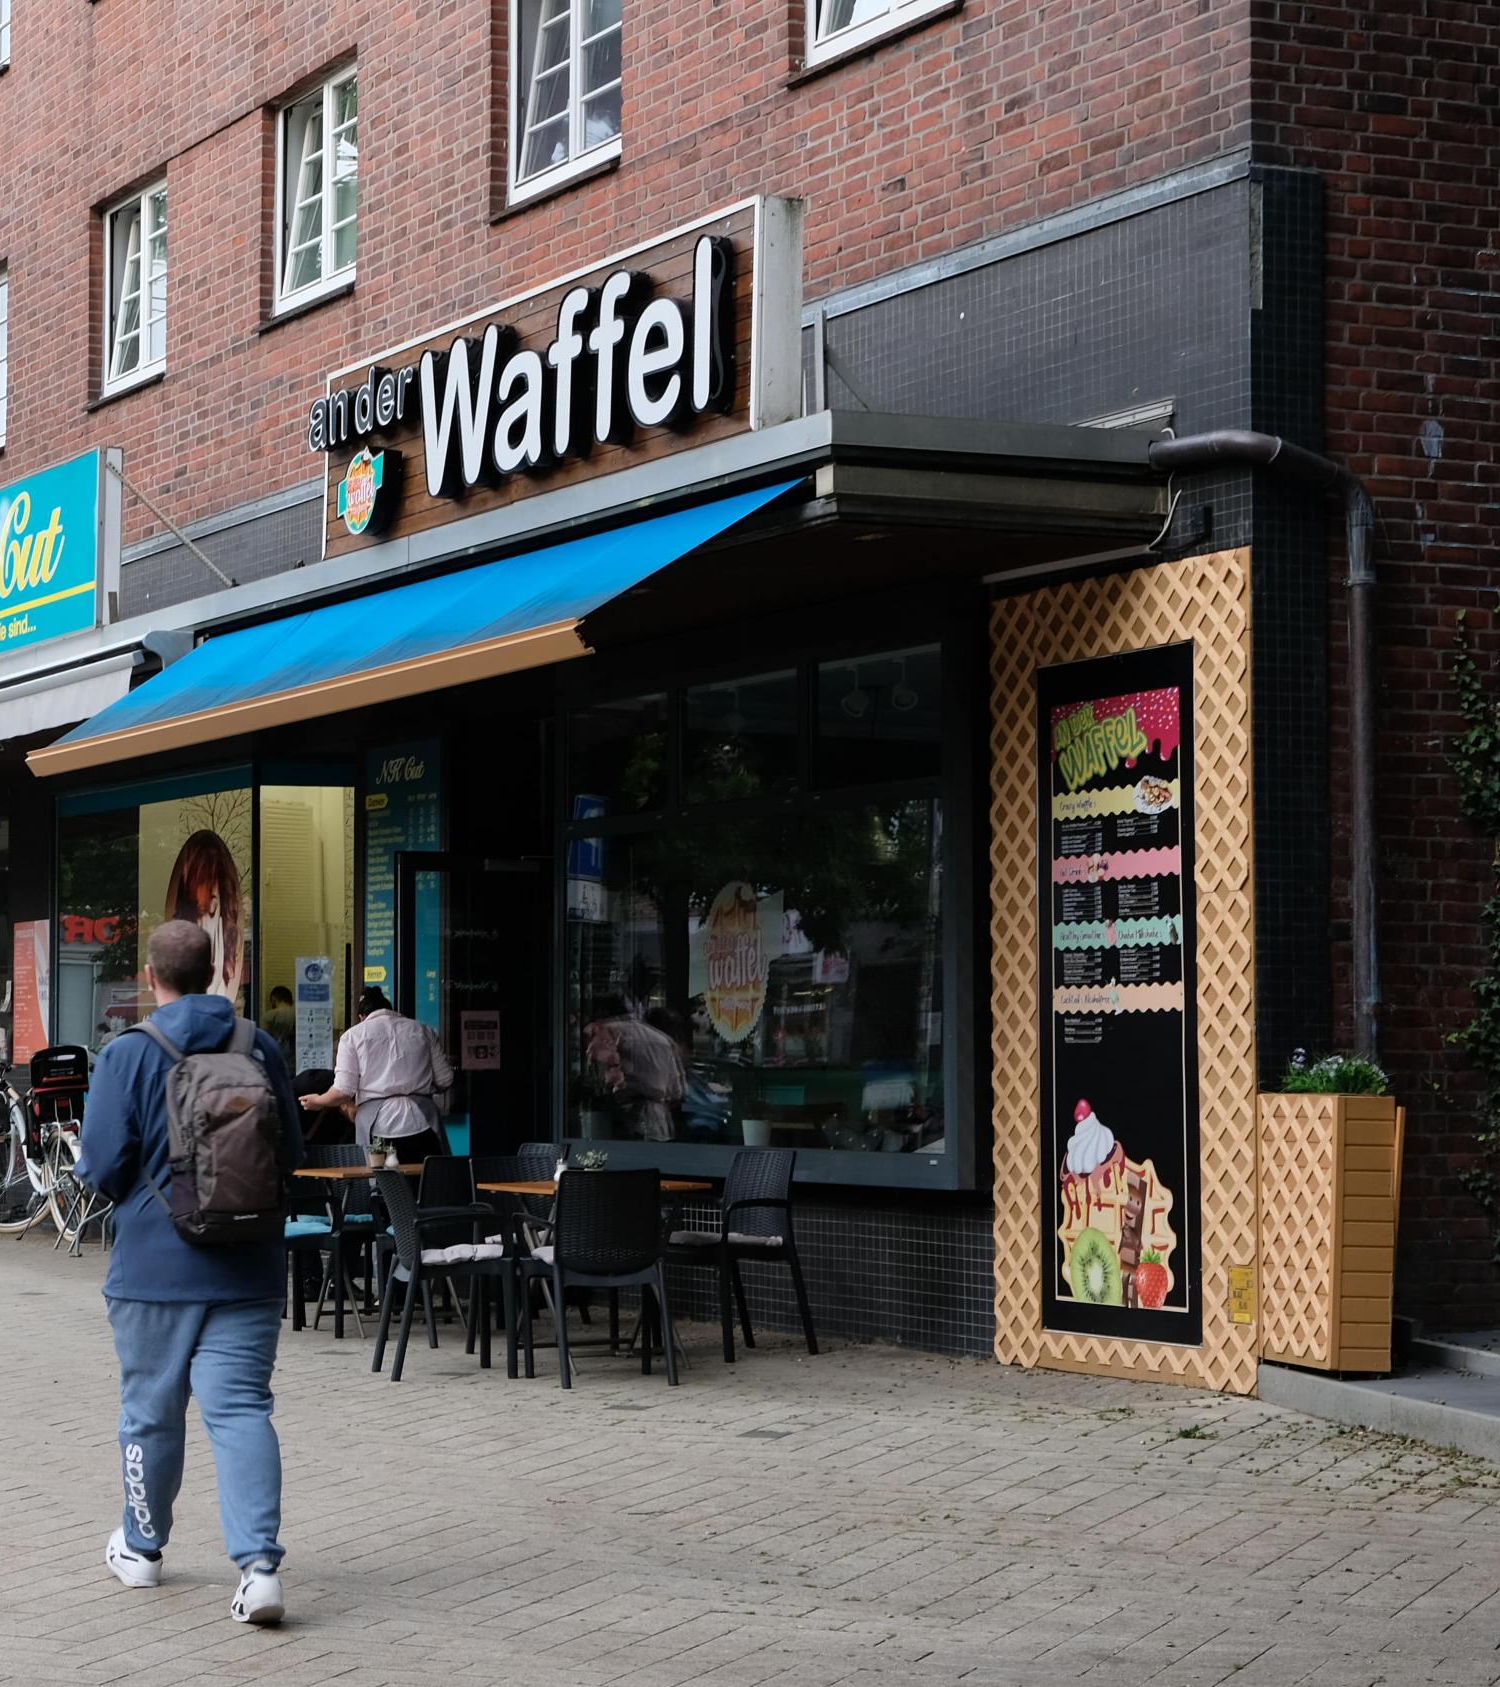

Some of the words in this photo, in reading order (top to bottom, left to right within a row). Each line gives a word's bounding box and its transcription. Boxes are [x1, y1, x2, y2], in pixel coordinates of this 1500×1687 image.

[308, 389, 349, 452] an
[354, 365, 414, 435] der
[418, 233, 716, 498] Waffel
[8, 613, 37, 639] sind...
[125, 1442, 156, 1539] adidas
